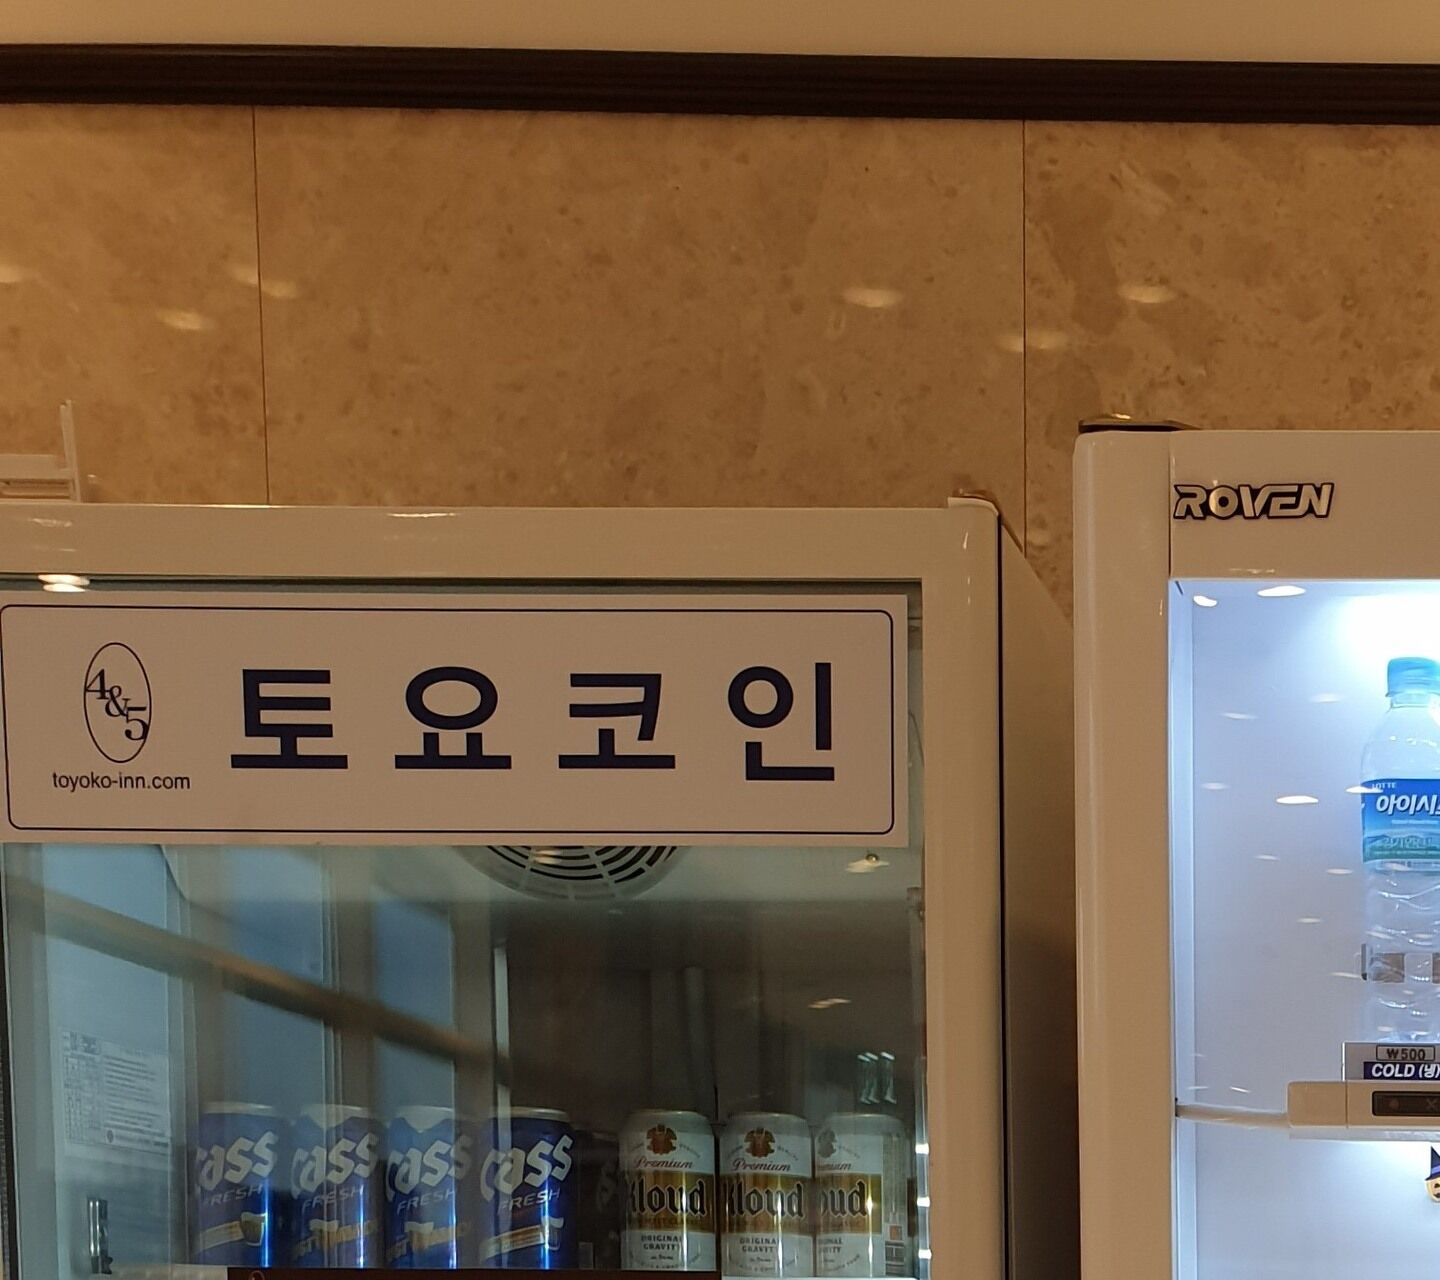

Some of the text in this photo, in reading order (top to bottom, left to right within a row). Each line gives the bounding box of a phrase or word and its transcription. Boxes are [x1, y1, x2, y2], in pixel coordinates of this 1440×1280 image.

[1173, 482, 1335, 520] ROVEN
[52, 771, 191, 795] toyoko-inn.com
[1371, 1063, 1415, 1078] COLD
[634, 1158, 693, 1170] Premium
[732, 1159, 792, 1172] Premium
[499, 1188, 560, 1211] FRESH
